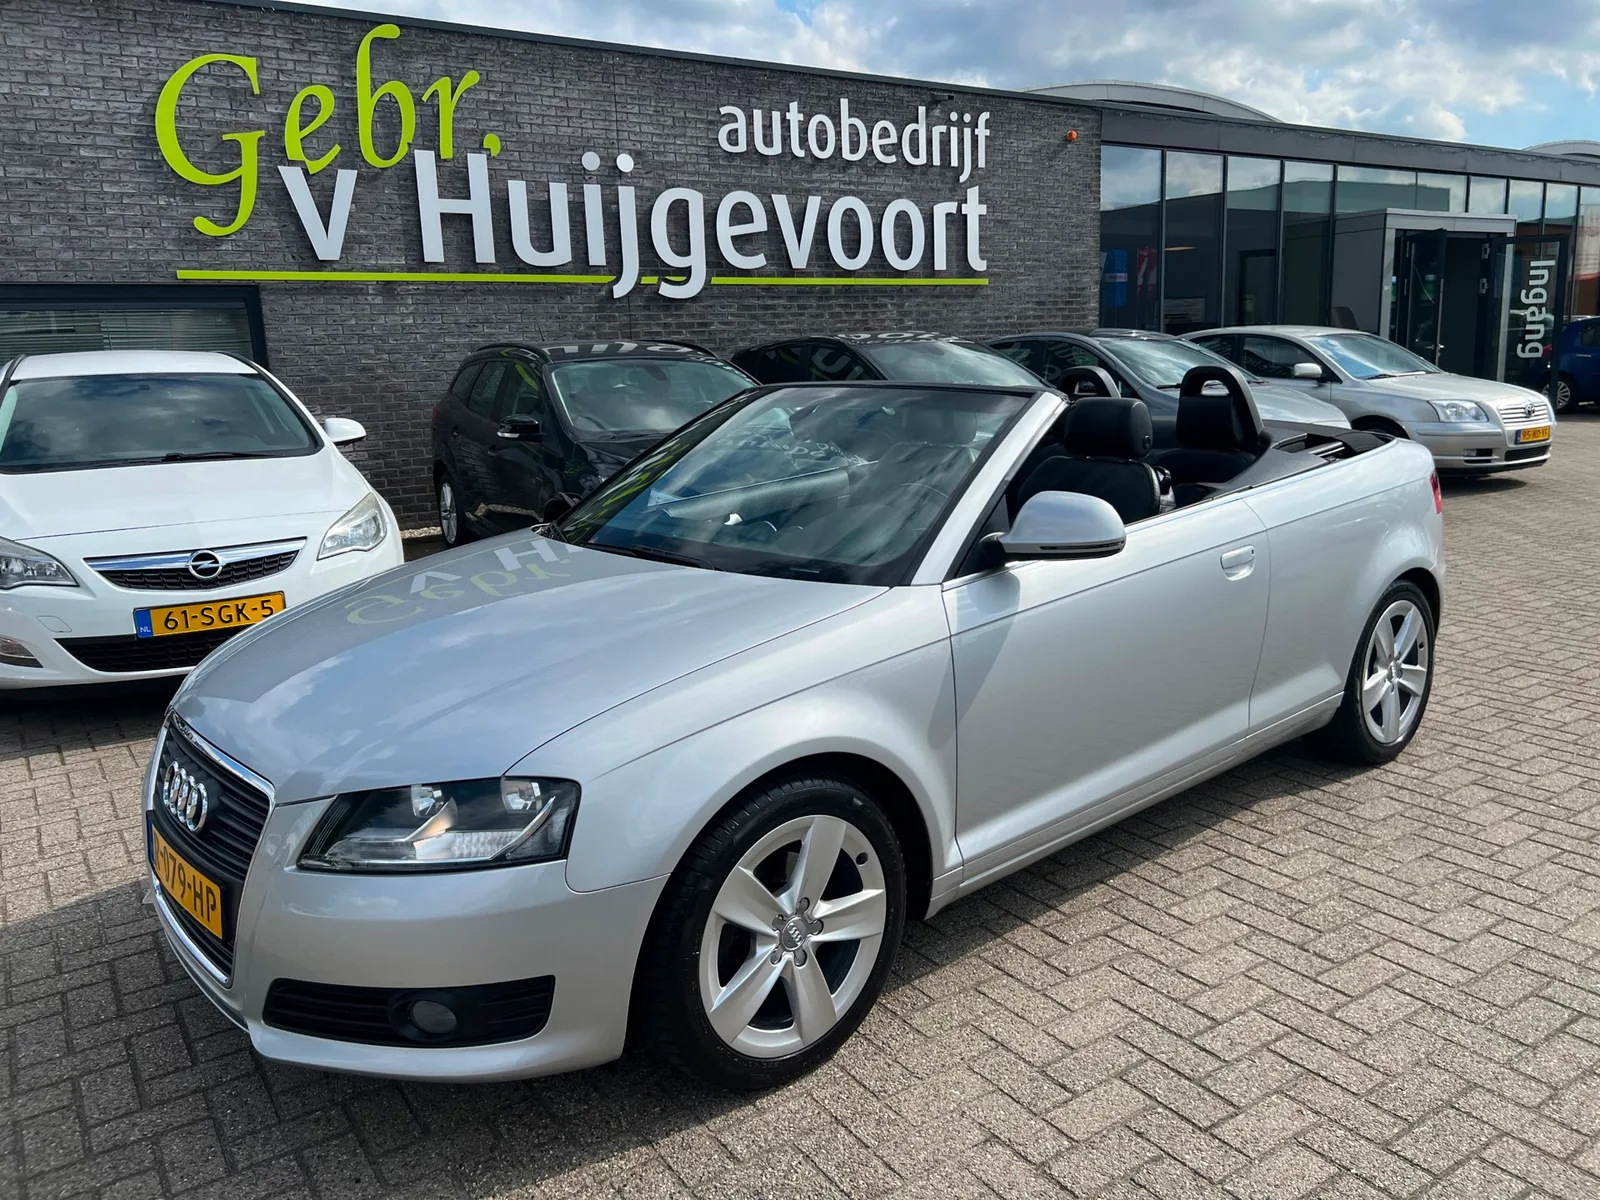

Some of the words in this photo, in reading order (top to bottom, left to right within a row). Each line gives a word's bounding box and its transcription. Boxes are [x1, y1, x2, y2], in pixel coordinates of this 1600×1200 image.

[155, 23, 501, 237] Gebr.
[718, 98, 990, 184] autobedrijf
[277, 165, 358, 261] v
[414, 149, 987, 299] Huijgevoort
[1516, 260, 1556, 359] Ingang
[164, 599, 274, 631] 61-SGK-5
